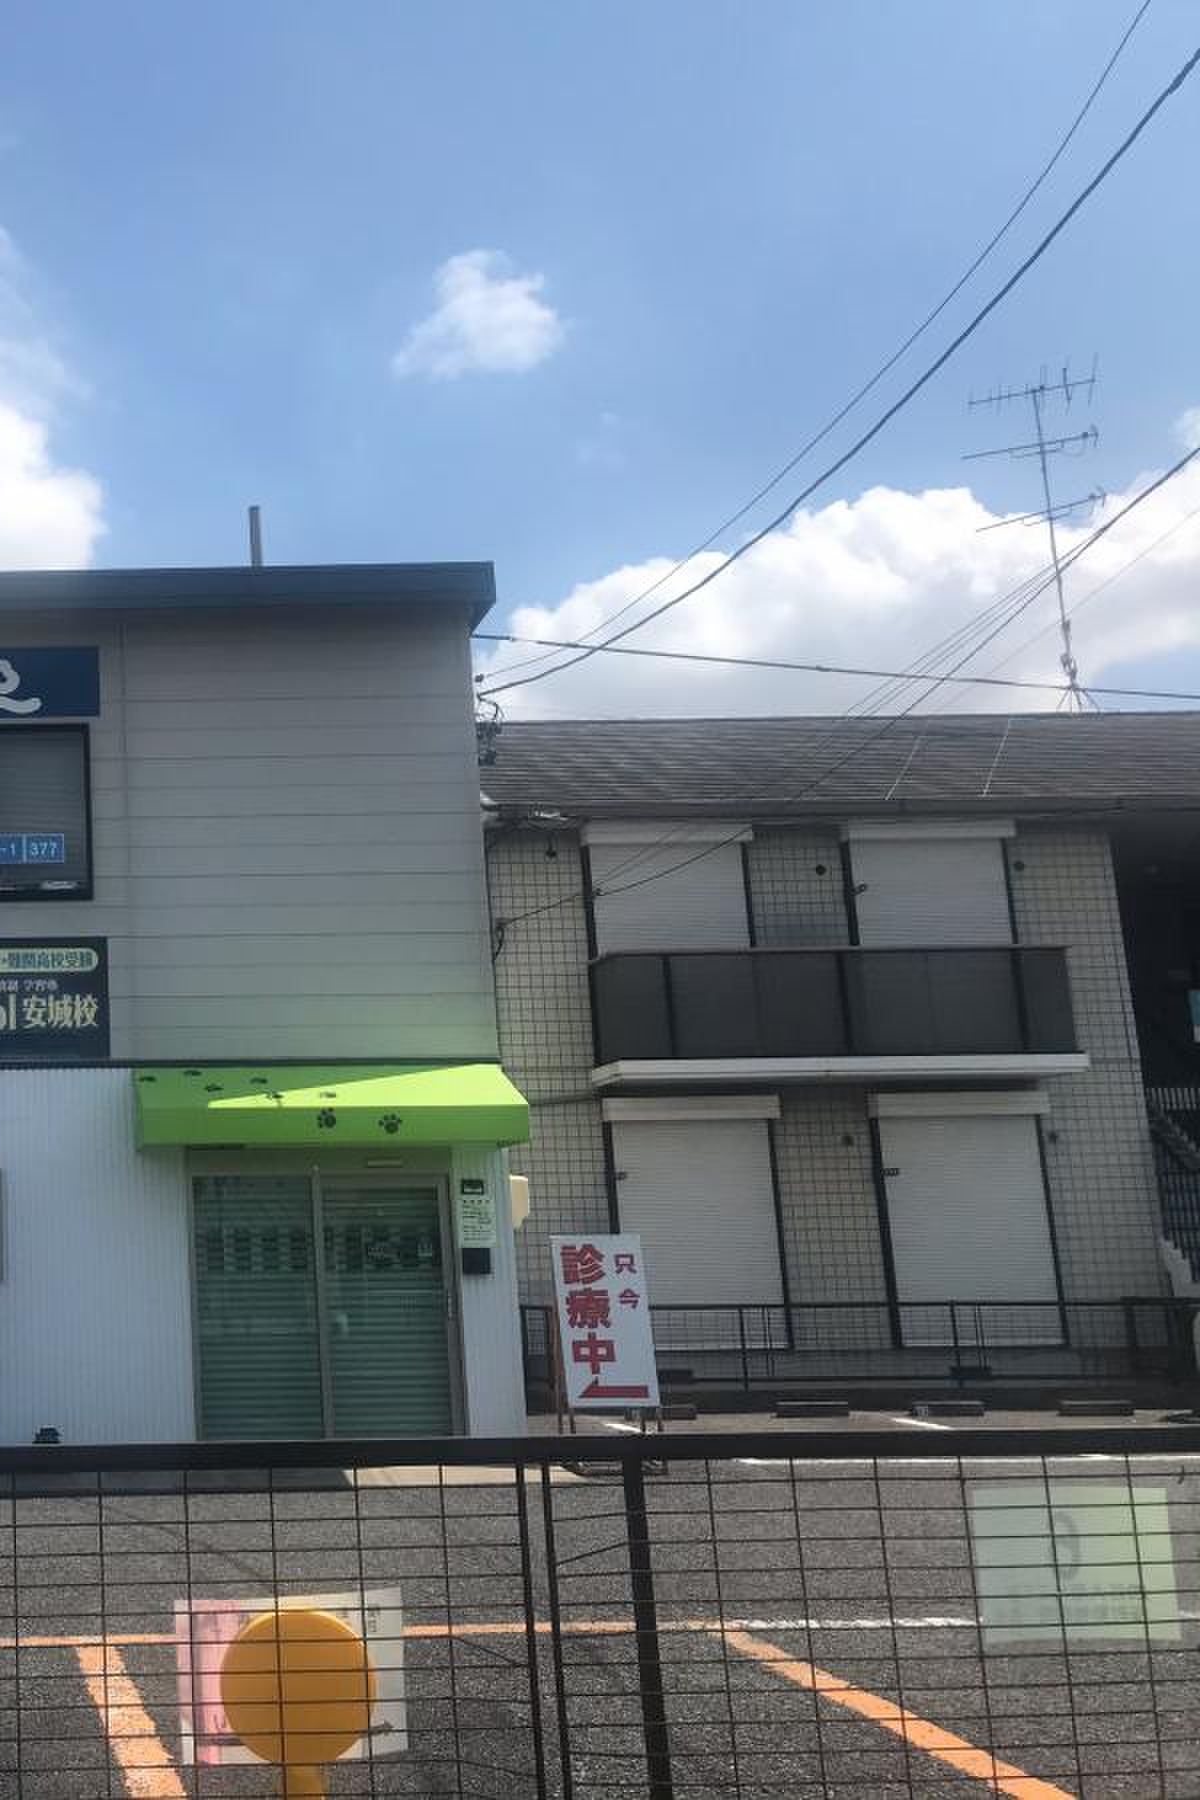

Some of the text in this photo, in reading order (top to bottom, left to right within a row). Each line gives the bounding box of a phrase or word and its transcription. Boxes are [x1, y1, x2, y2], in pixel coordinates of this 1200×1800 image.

[22, 994, 99, 1030] 安城校
[560, 1243, 616, 1375] 診療中
[614, 1253, 641, 1309] 只今
